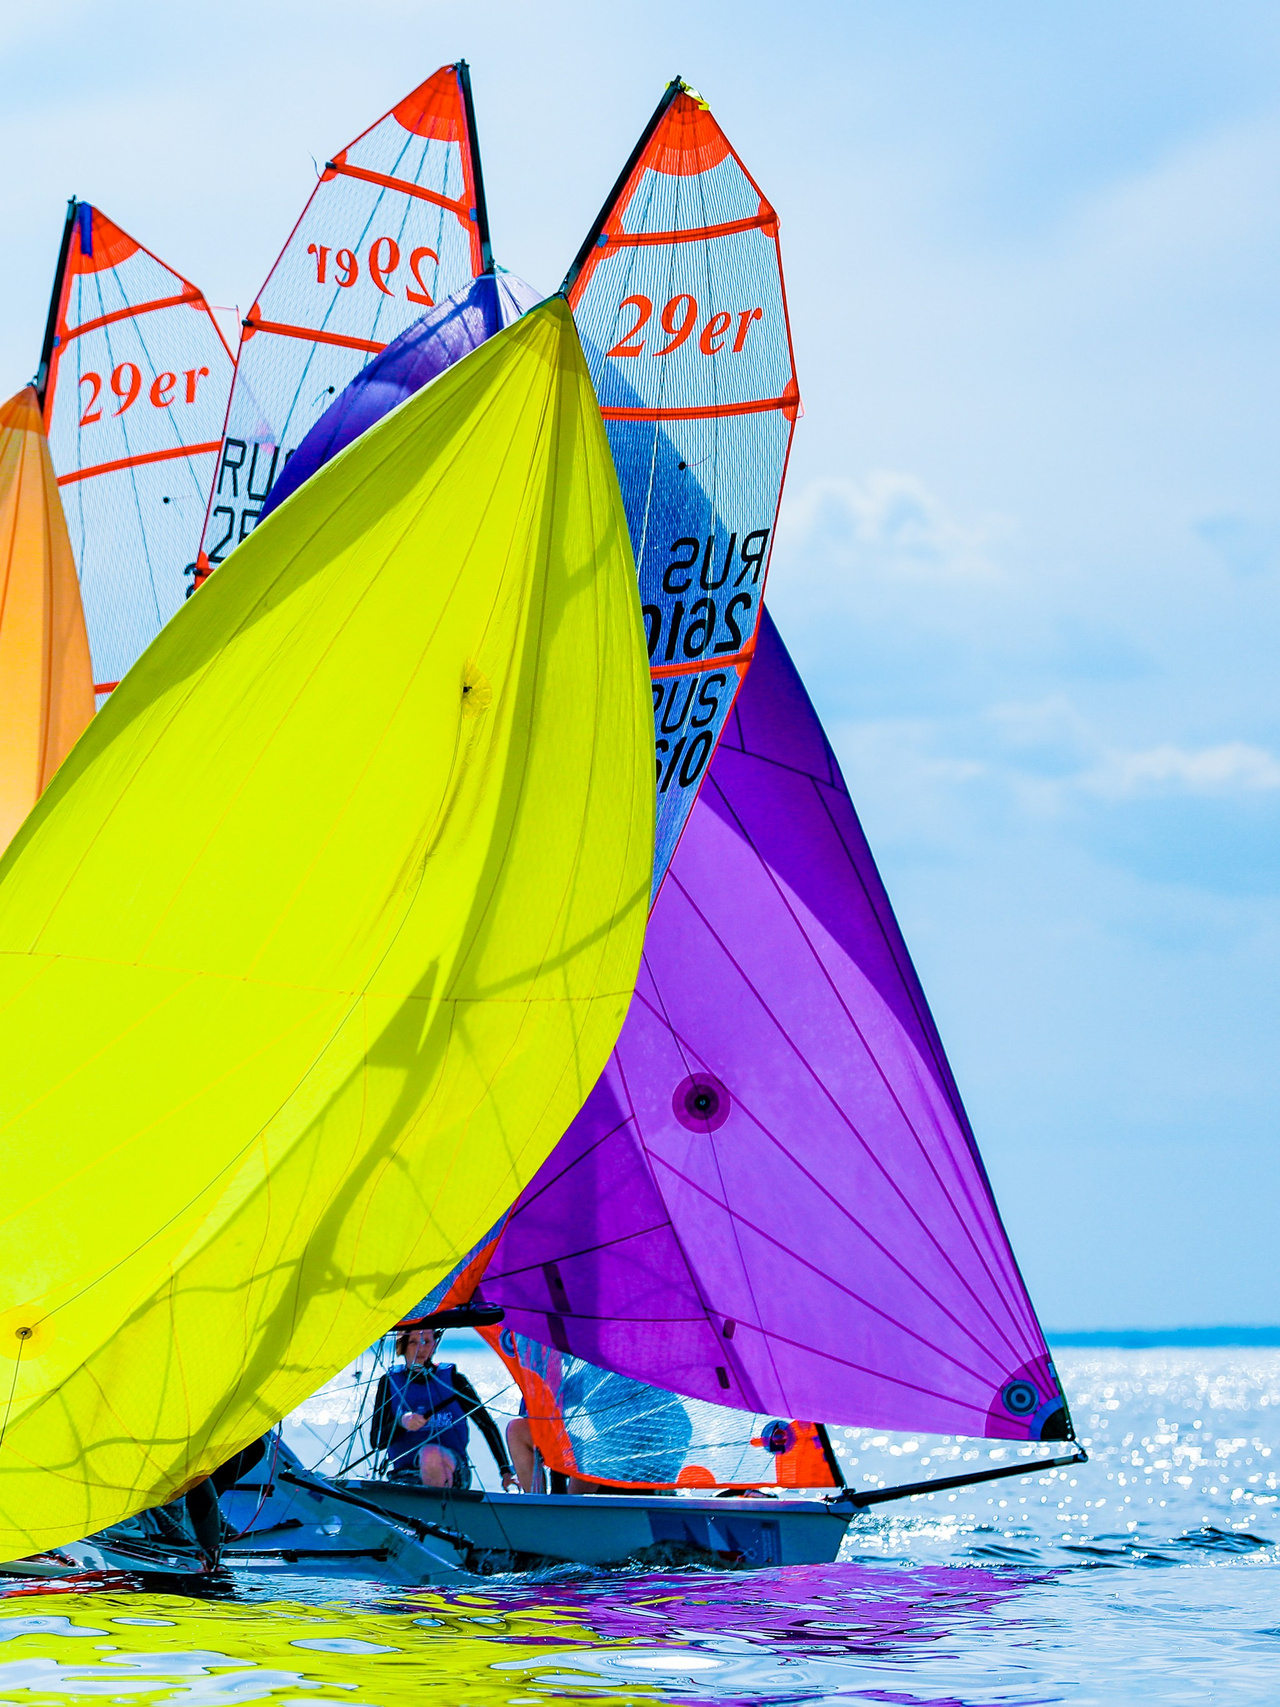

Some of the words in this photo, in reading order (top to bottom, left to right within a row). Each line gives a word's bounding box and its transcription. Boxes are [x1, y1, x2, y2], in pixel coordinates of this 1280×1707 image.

[606, 293, 763, 357] 29er
[78, 362, 210, 428] 29er
[217, 437, 298, 501] RU
